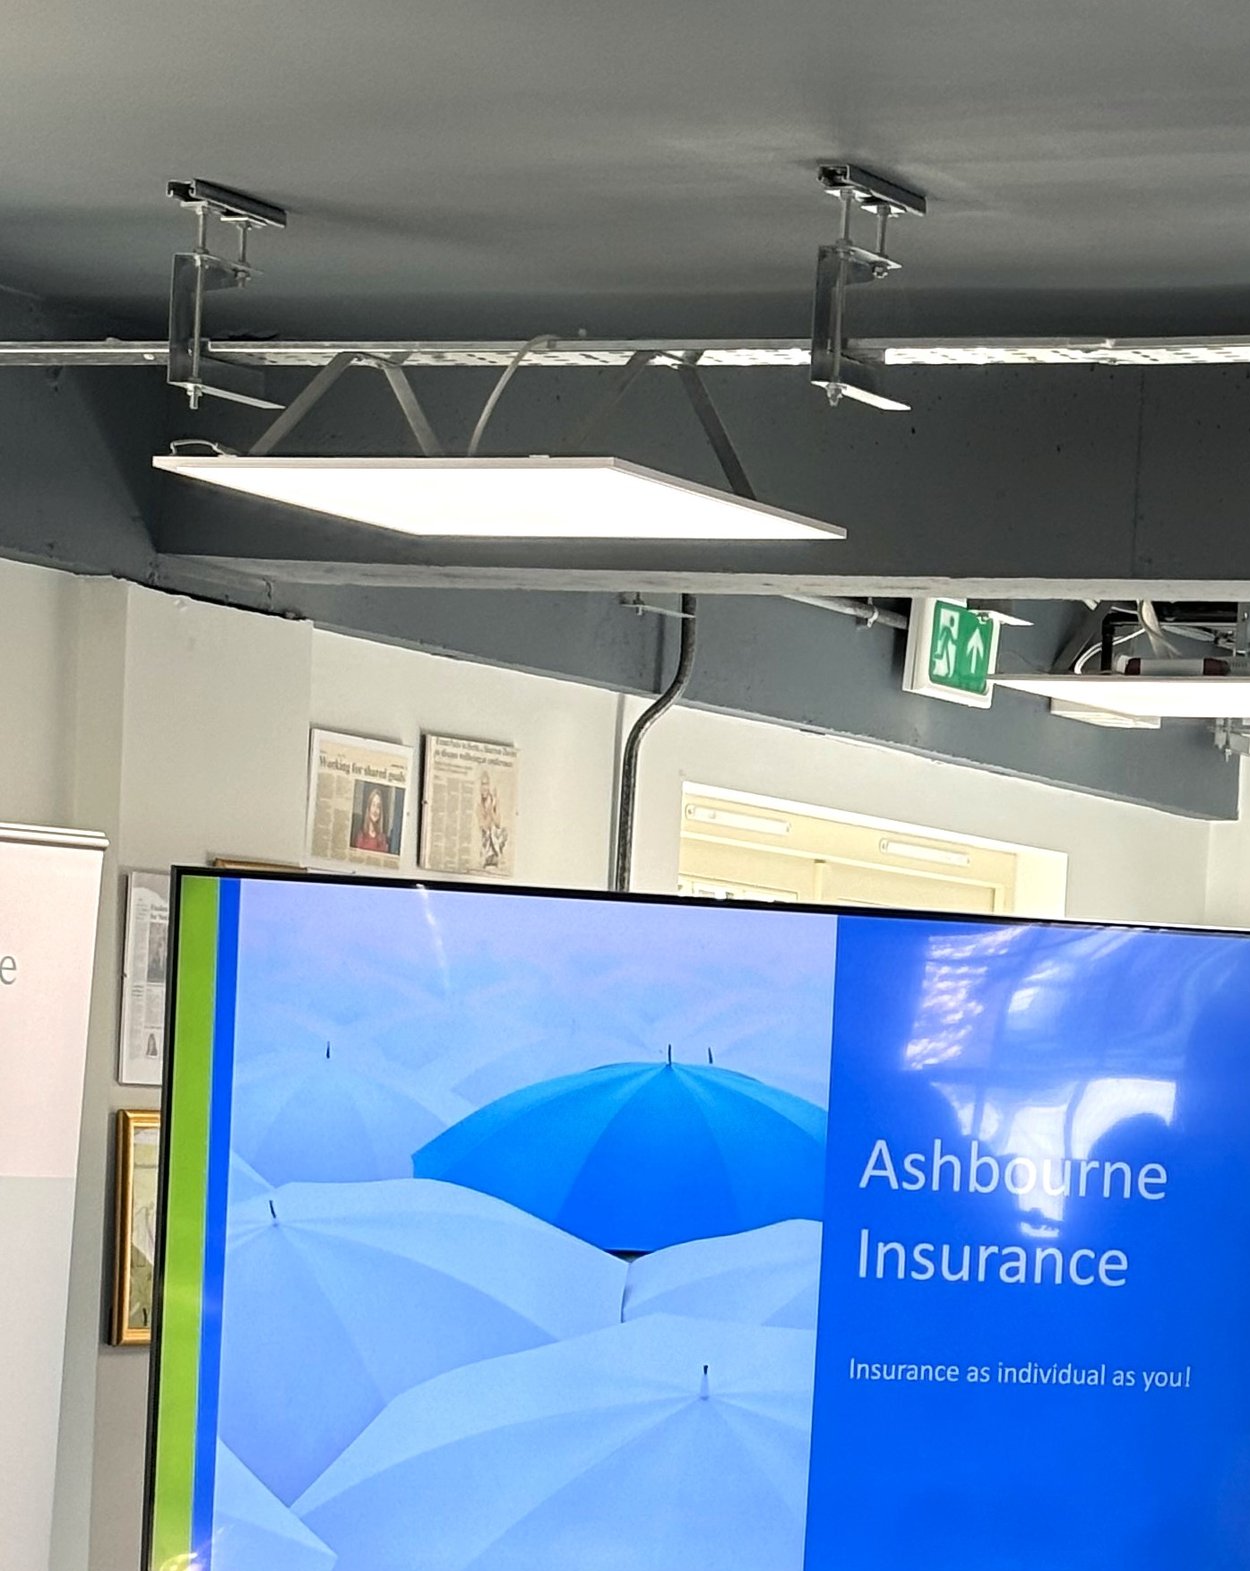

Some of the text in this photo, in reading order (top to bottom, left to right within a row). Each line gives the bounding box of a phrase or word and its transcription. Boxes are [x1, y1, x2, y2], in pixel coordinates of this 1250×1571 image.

[858, 1138, 1169, 1201] Ashbourne
[857, 1228, 1129, 1287] Insurance
[849, 1357, 1192, 1392] Insurance as individual as you!
